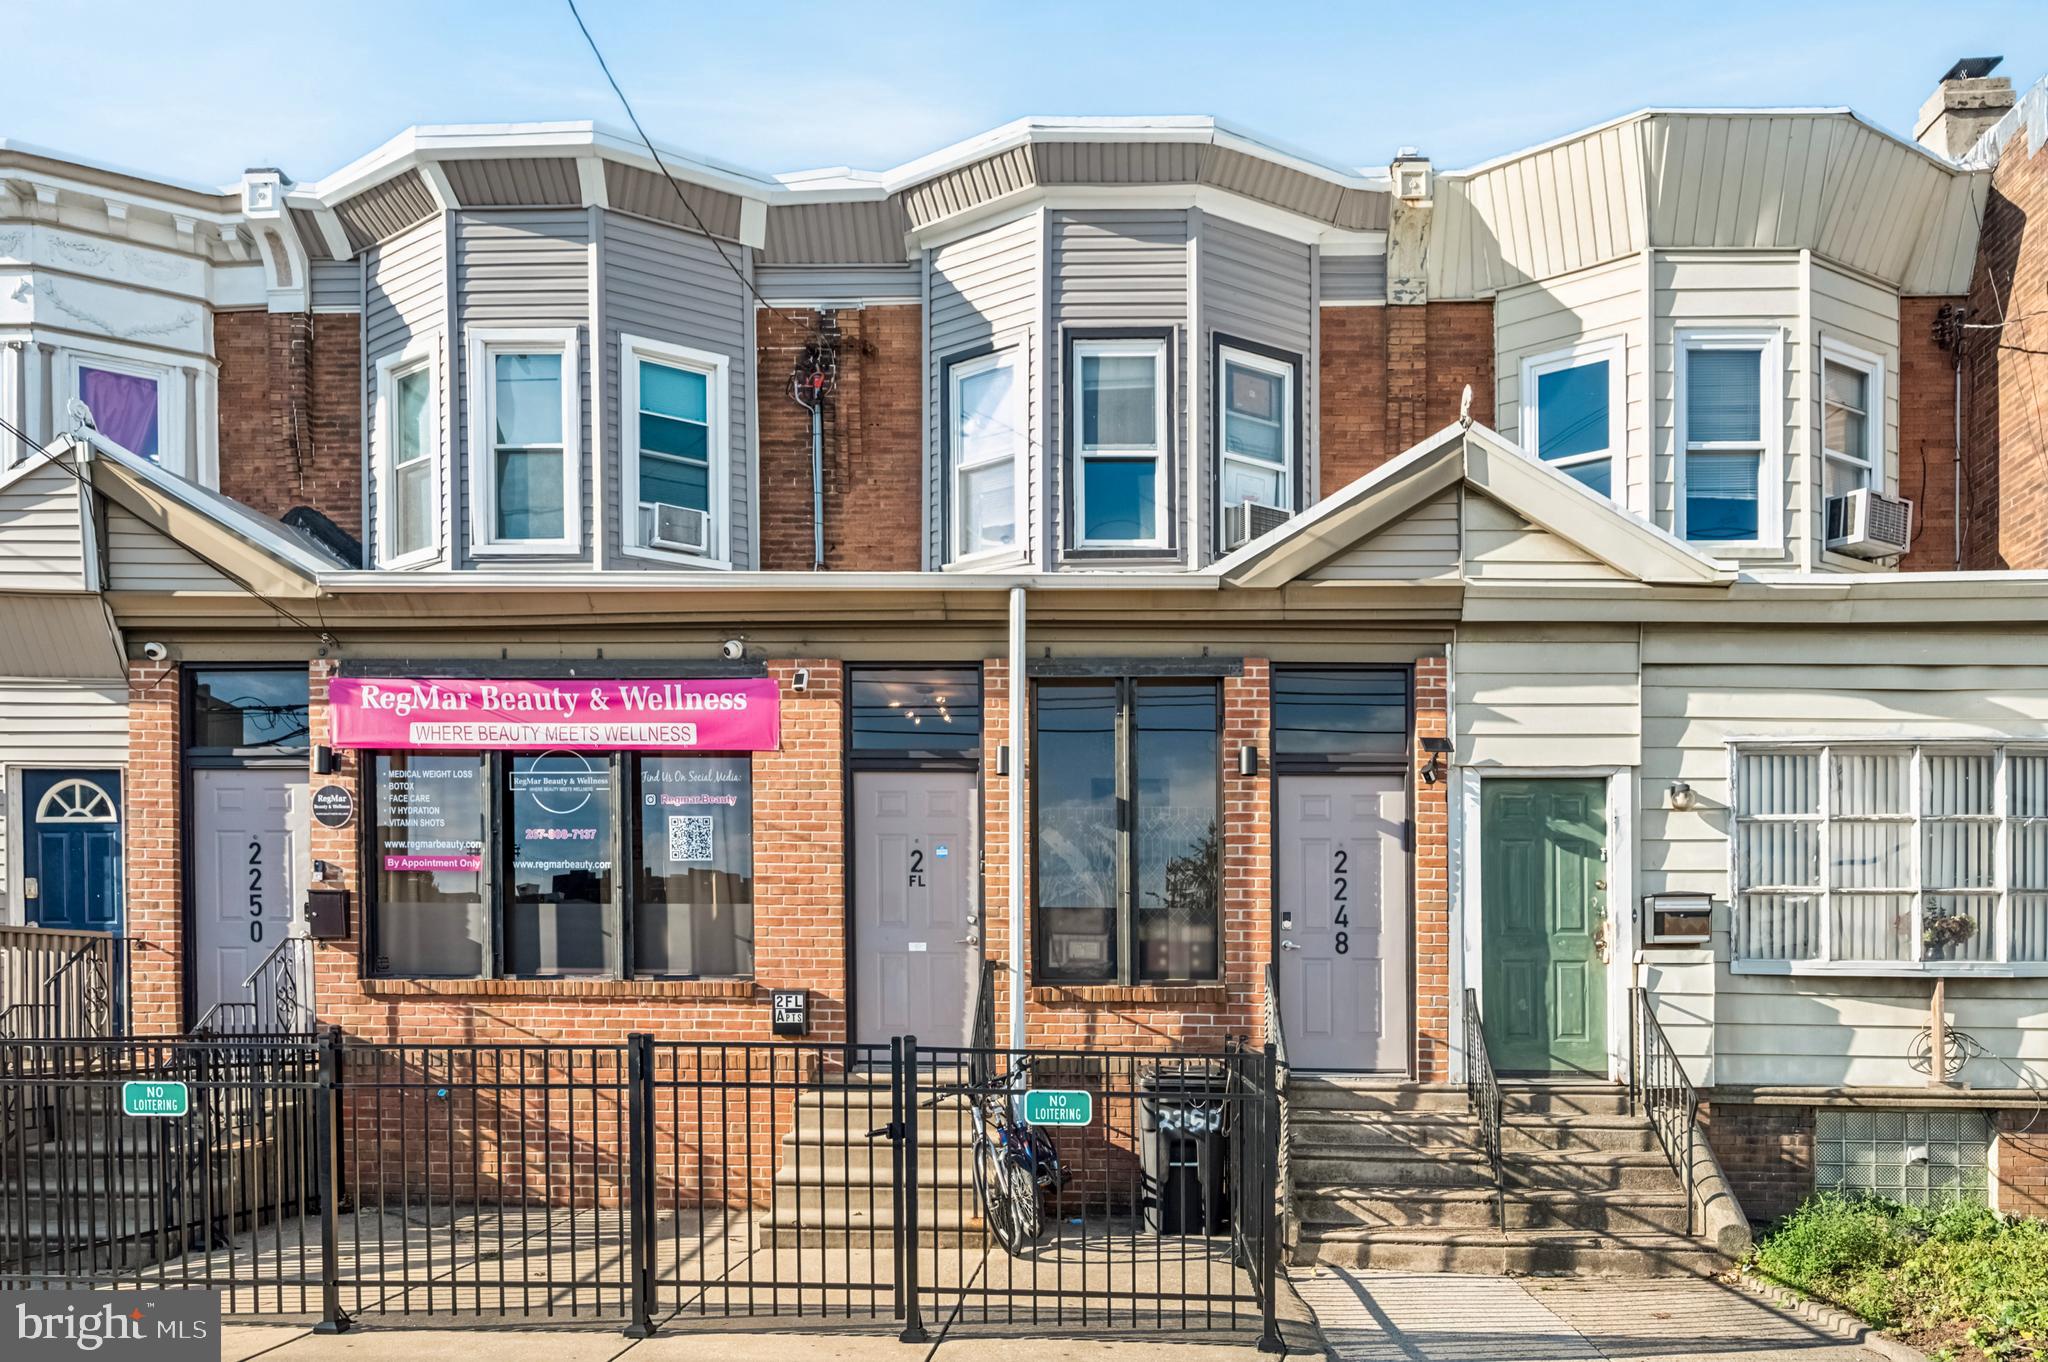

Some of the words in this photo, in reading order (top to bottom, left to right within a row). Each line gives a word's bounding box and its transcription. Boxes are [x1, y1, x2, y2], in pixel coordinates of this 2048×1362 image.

[360, 685, 471, 716] RegMar
[480, 685, 580, 718] Beauty
[590, 687, 610, 711] &
[618, 684, 747, 711] Wellness
[415, 725, 474, 741] WHERE
[478, 725, 539, 742] BEAUTY
[545, 725, 599, 742] MEETS
[604, 726, 691, 742] WELLNESS
[388, 770, 421, 778] MEDICAL
[422, 770, 450, 778] WEIGHT
[453, 770, 473, 778] LOSS
[641, 769, 660, 783] Find
[662, 771, 672, 782] Us
[674, 769, 686, 782] On
[688, 769, 713, 783] Social
[388, 782, 415, 791] BOTOX
[513, 777, 541, 786] RegMar
[543, 777, 568, 786] Beauty
[577, 777, 609, 785] Wellness
[317, 794, 347, 804] RegMar
[388, 794, 408, 803] FACE
[410, 794, 431, 803] CARE
[388, 806, 397, 815] IV
[397, 806, 440, 815] HYDRATION
[389, 818, 418, 827] VITAMIN
[420, 818, 446, 827] SHOTS
[387, 858, 400, 868] By
[401, 858, 458, 868] Appointment
[459, 858, 481, 869] Only
[910, 849, 924, 873] 2
[908, 874, 926, 888] FL
[248, 841, 264, 943] 2250
[1333, 849, 1350, 955] 2248
[146, 1086, 164, 1098] NO
[133, 1099, 178, 1111] LOITERING
[1049, 1095, 1067, 1107] NO
[1035, 1108, 1081, 1120] LOITERING
